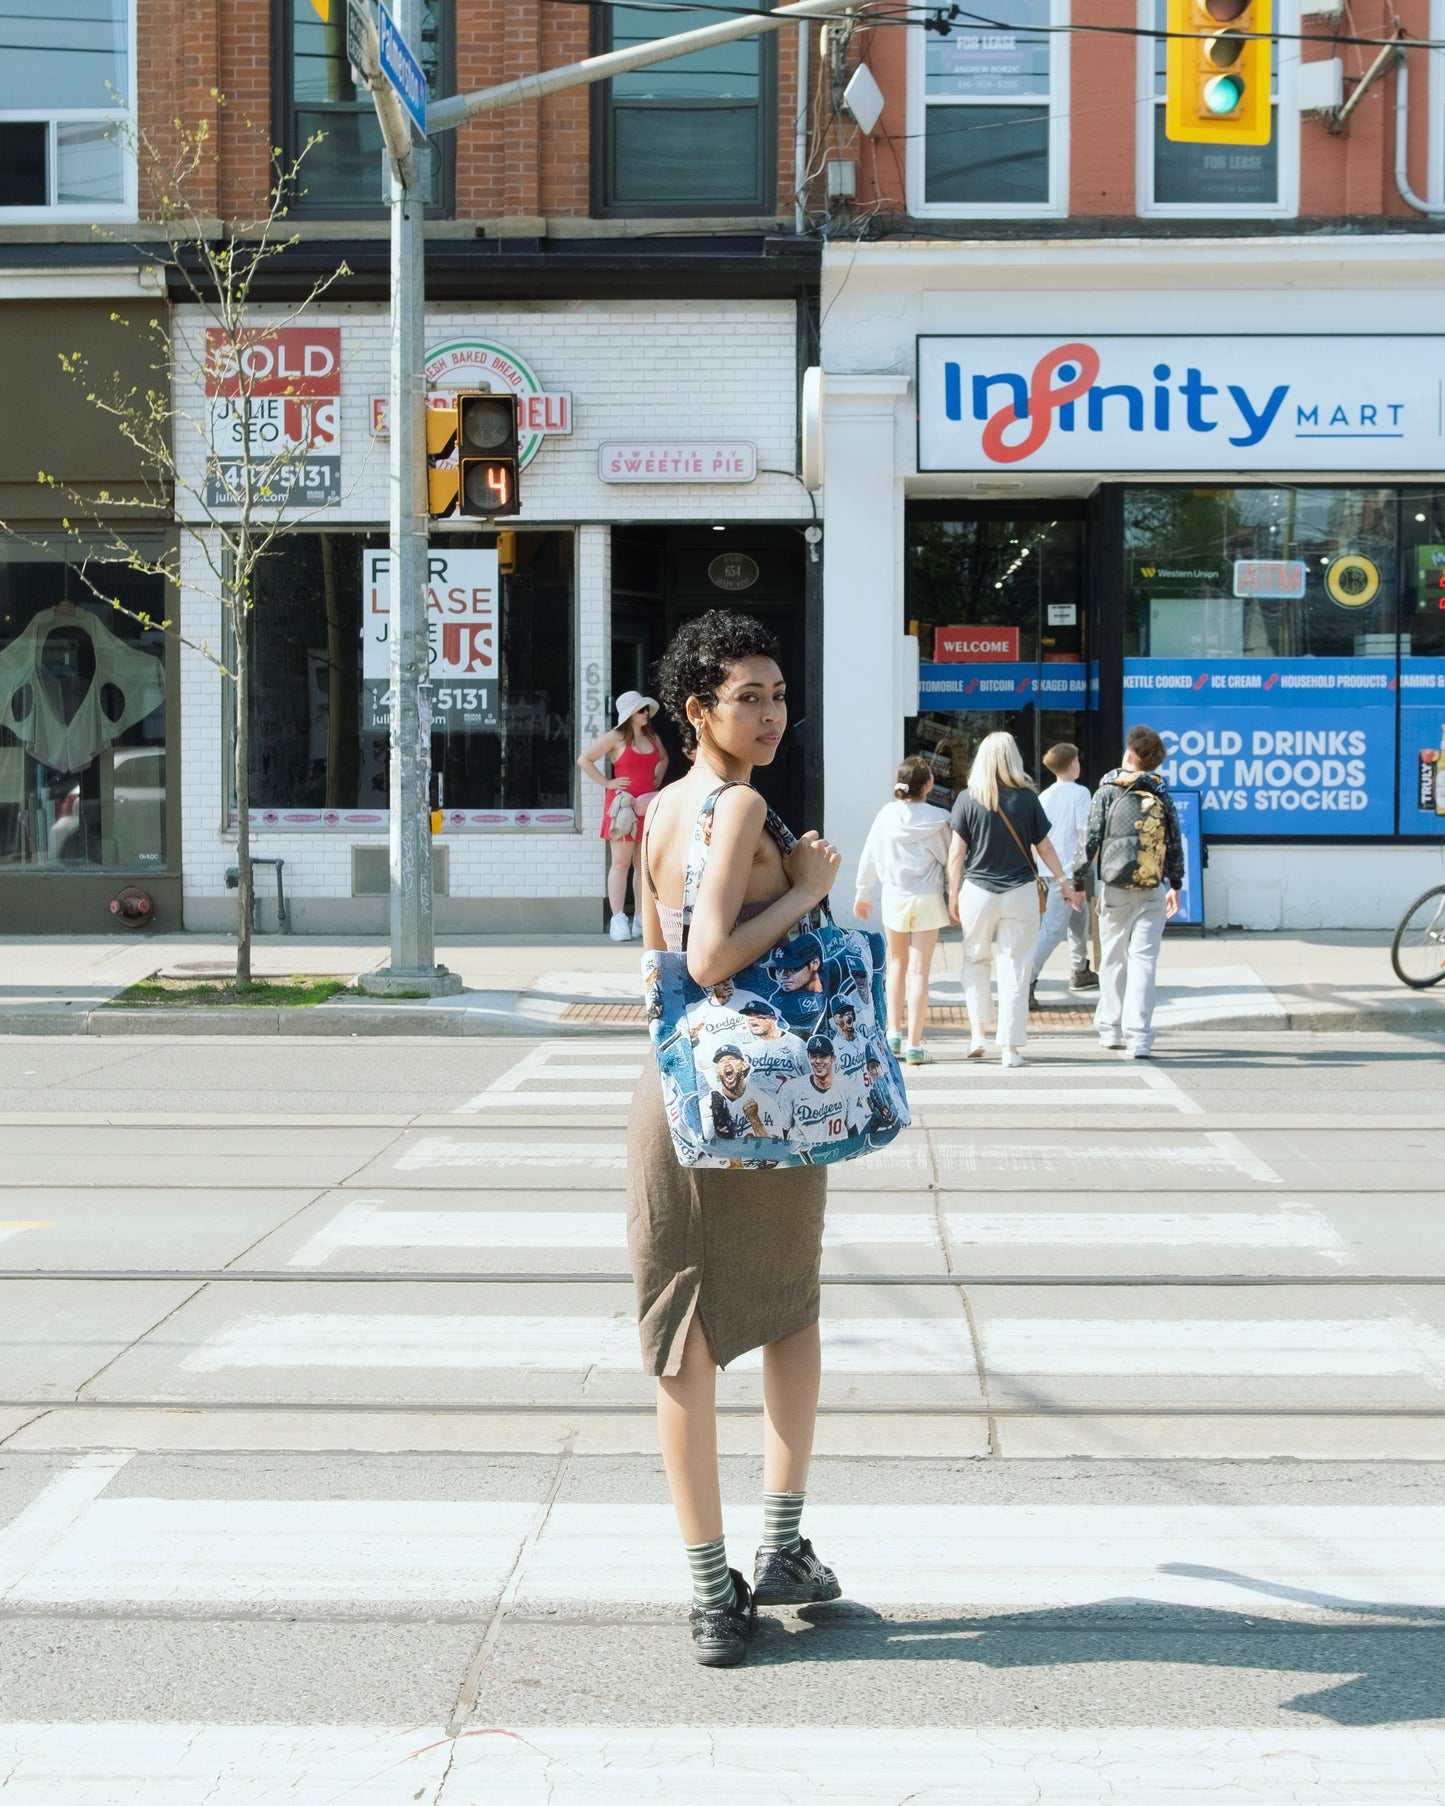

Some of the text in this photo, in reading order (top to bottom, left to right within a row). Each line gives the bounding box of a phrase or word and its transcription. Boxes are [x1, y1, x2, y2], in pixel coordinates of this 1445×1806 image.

[957, 36, 1016, 50] FOR LEASE
[1204, 156, 1262, 170] FOR LEASE
[212, 345, 334, 378] SOLD
[426, 352, 522, 386] ESH BAKED BREAD
[1297, 405, 1404, 426] MART
[232, 423, 279, 442] SEO
[611, 459, 744, 472] SWEETIE PIE
[488, 467, 506, 504] 4
[372, 558, 447, 583] FR
[1157, 568, 1219, 578] Western Union
[1239, 566, 1302, 592] ATM
[372, 588, 492, 614] LASE
[943, 641, 1009, 652] WELCOME
[918, 680, 1014, 692] TOMOBILE BITCOIN
[1123, 675, 1154, 688] KETTLE
[1156, 675, 1192, 688] COOKED
[1211, 675, 1226, 688] ICE
[1228, 675, 1261, 688] CREAM
[1281, 675, 1335, 688] HOUSEHOLD
[1337, 675, 1387, 688] PRODUCTS
[1159, 730, 1366, 755] COLD DRINKS
[1235, 760, 1366, 787] MOODS
[1421, 763, 1433, 804] TRULY
[1201, 789, 1368, 810] AYS STOCKED
[745, 1052, 795, 1076] odgers
[764, 1111, 774, 1126] LA
[797, 1101, 843, 1124] Dodgers
[828, 1117, 843, 1137] 10
